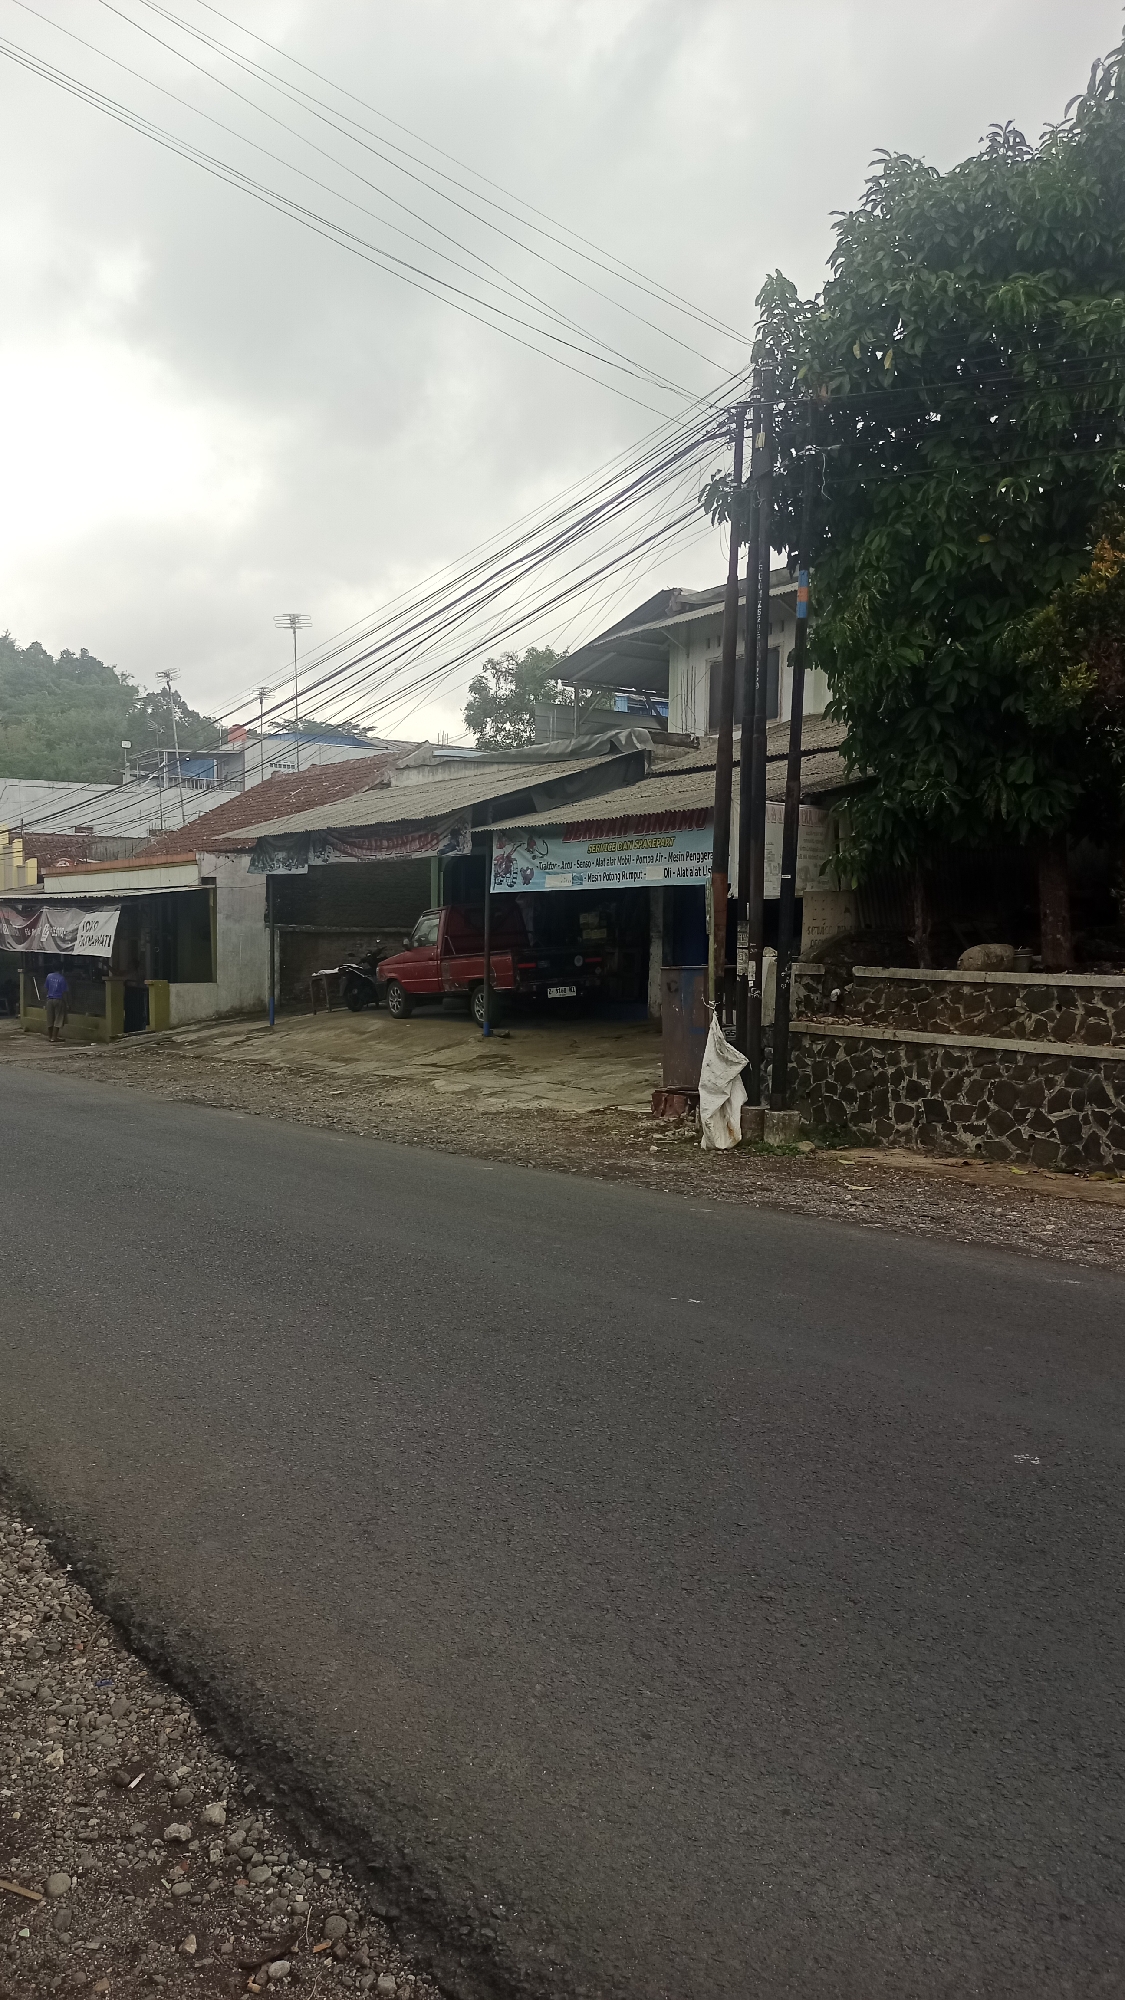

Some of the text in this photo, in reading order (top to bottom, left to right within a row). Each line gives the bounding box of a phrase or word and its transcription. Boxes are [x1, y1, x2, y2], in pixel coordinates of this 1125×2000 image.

[587, 836, 675, 854] SERVICE DAN SPAREPART
[655, 852, 663, 863] Air
[668, 851, 684, 862] Mesin
[587, 872, 602, 882] Mesin
